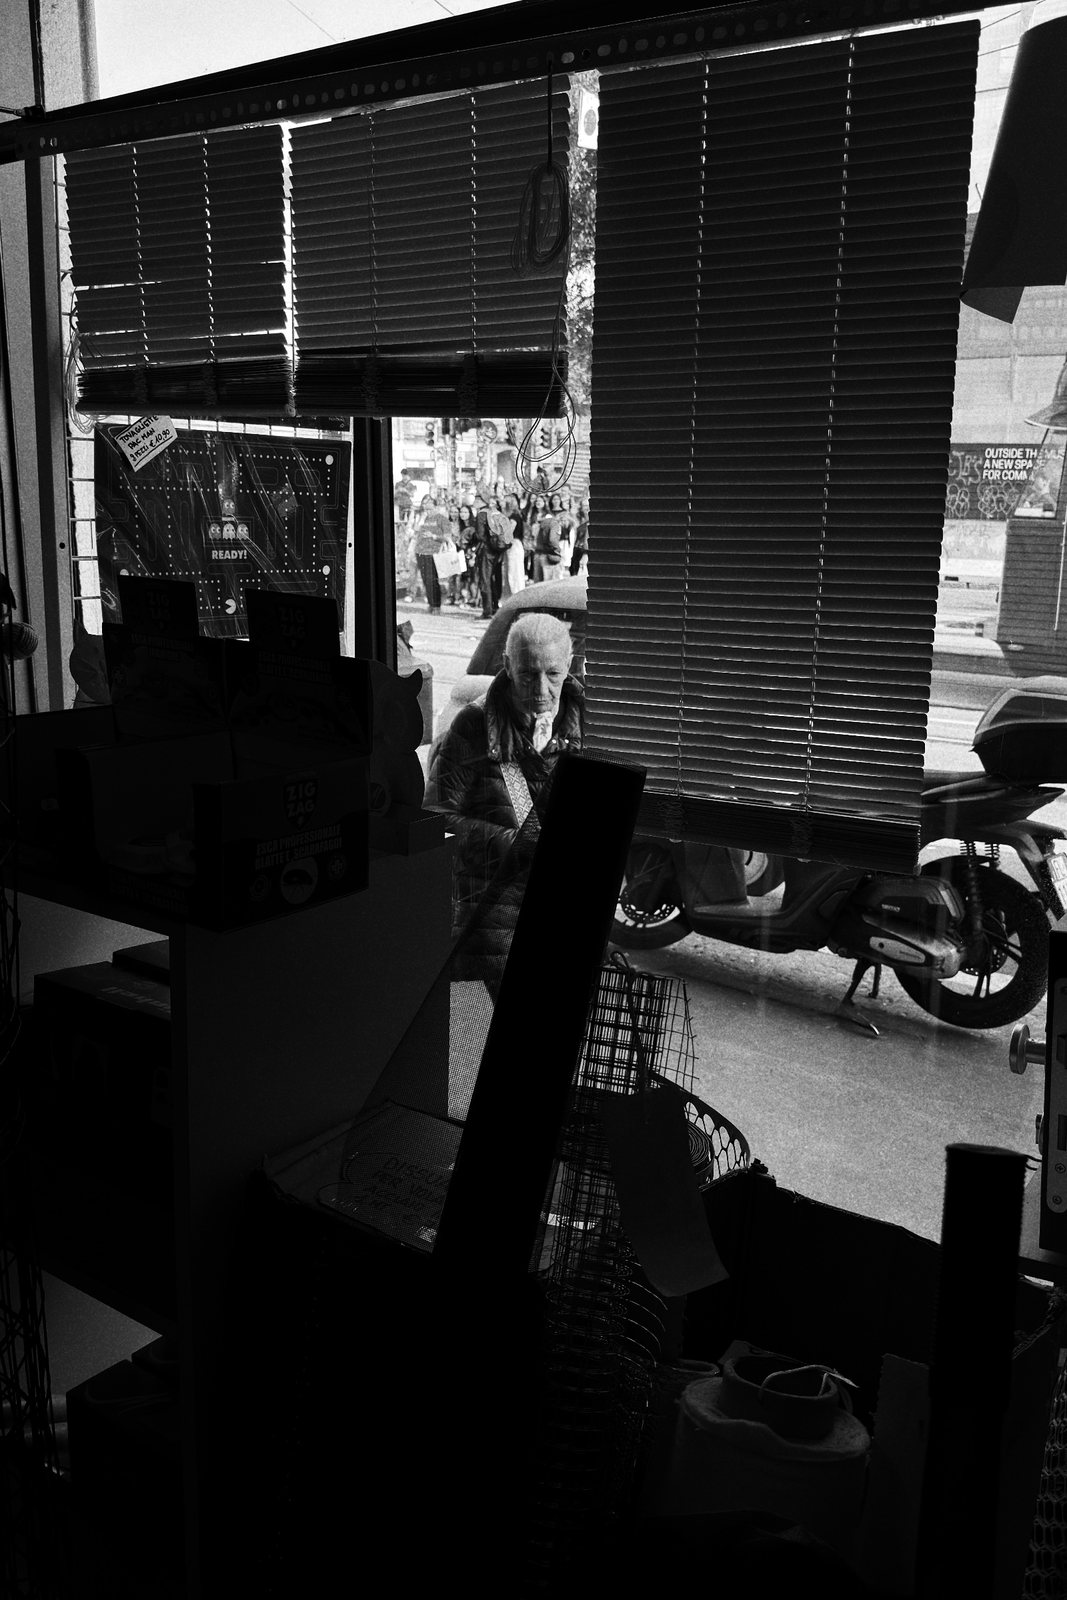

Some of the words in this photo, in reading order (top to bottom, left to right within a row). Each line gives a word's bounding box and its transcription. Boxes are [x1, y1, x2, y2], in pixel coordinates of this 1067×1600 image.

[128, 438, 142, 450] PAC
[141, 427, 155, 440] MAN
[984, 448, 1024, 459] OUTSIDE
[983, 459, 990, 469] A
[991, 459, 1014, 470] NEW
[982, 469, 1001, 480] FOR
[211, 549, 247, 560] READY!
[286, 782, 316, 802] ZIG
[286, 799, 315, 819] ZAG
